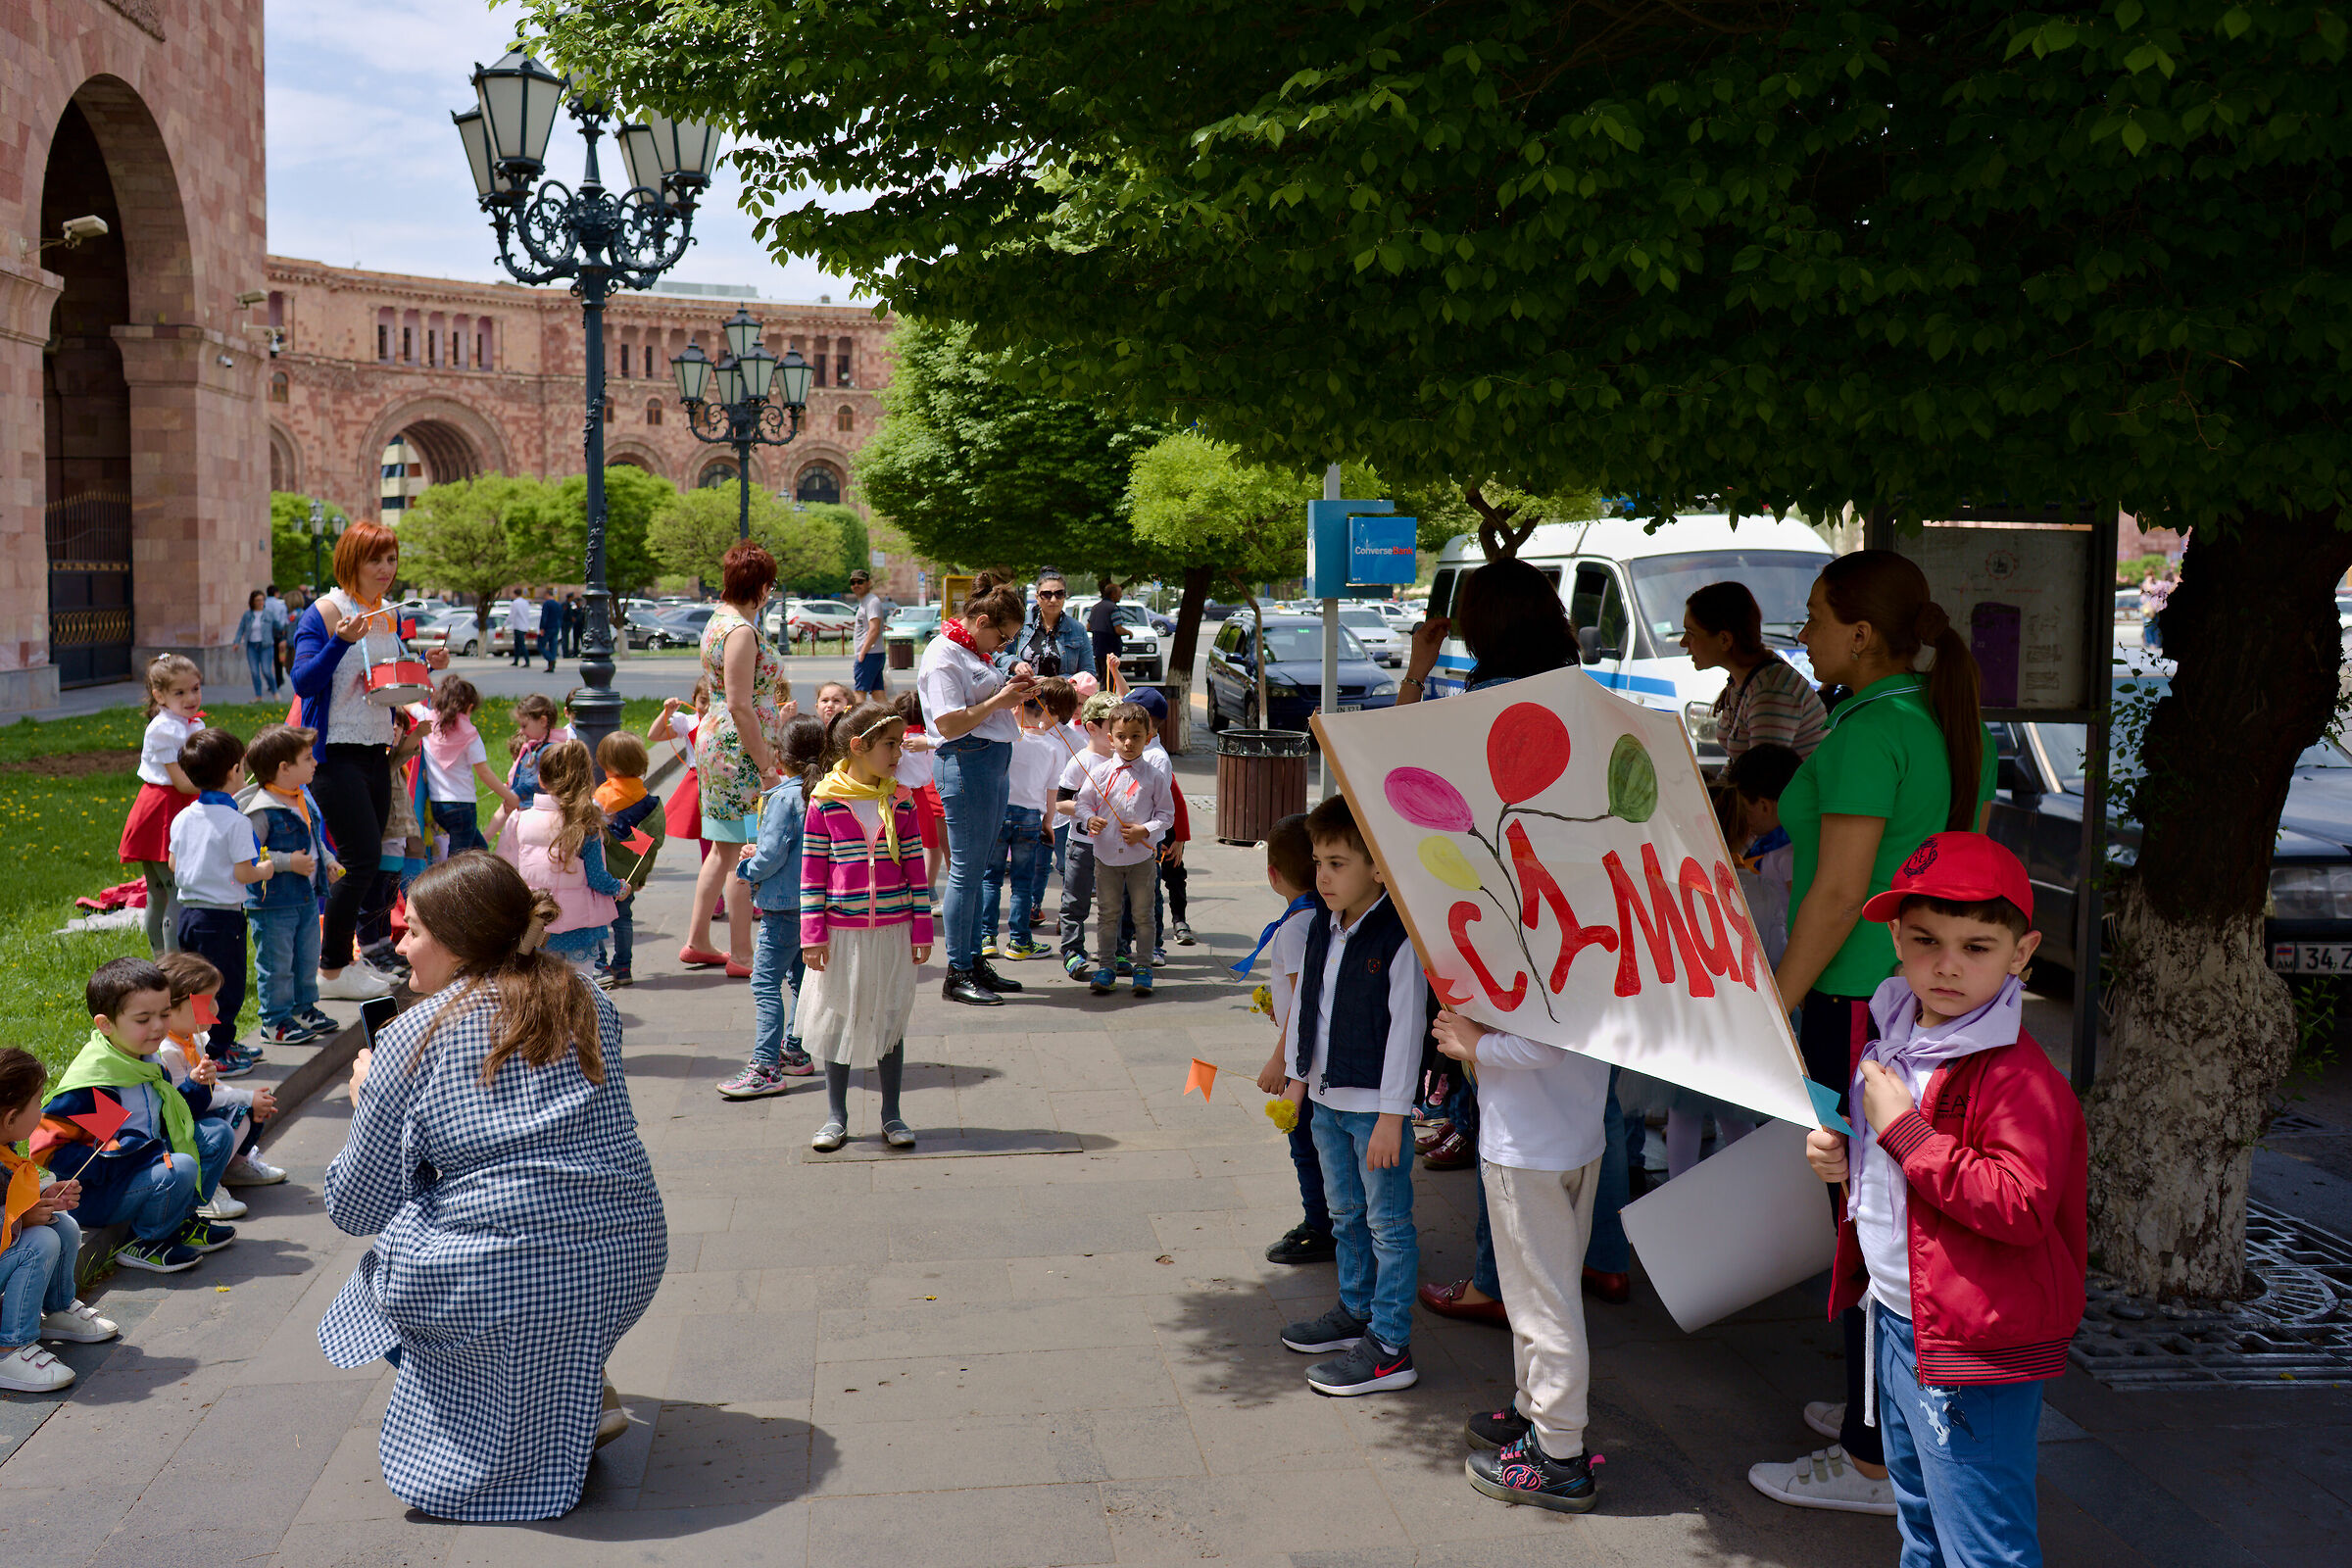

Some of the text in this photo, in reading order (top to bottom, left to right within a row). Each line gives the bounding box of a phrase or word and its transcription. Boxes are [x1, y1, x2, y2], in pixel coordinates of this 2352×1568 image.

[1354, 546, 1413, 556] ConverseBank
[1505, 818, 1619, 995] 1
[2306, 948, 2333, 970] 34
